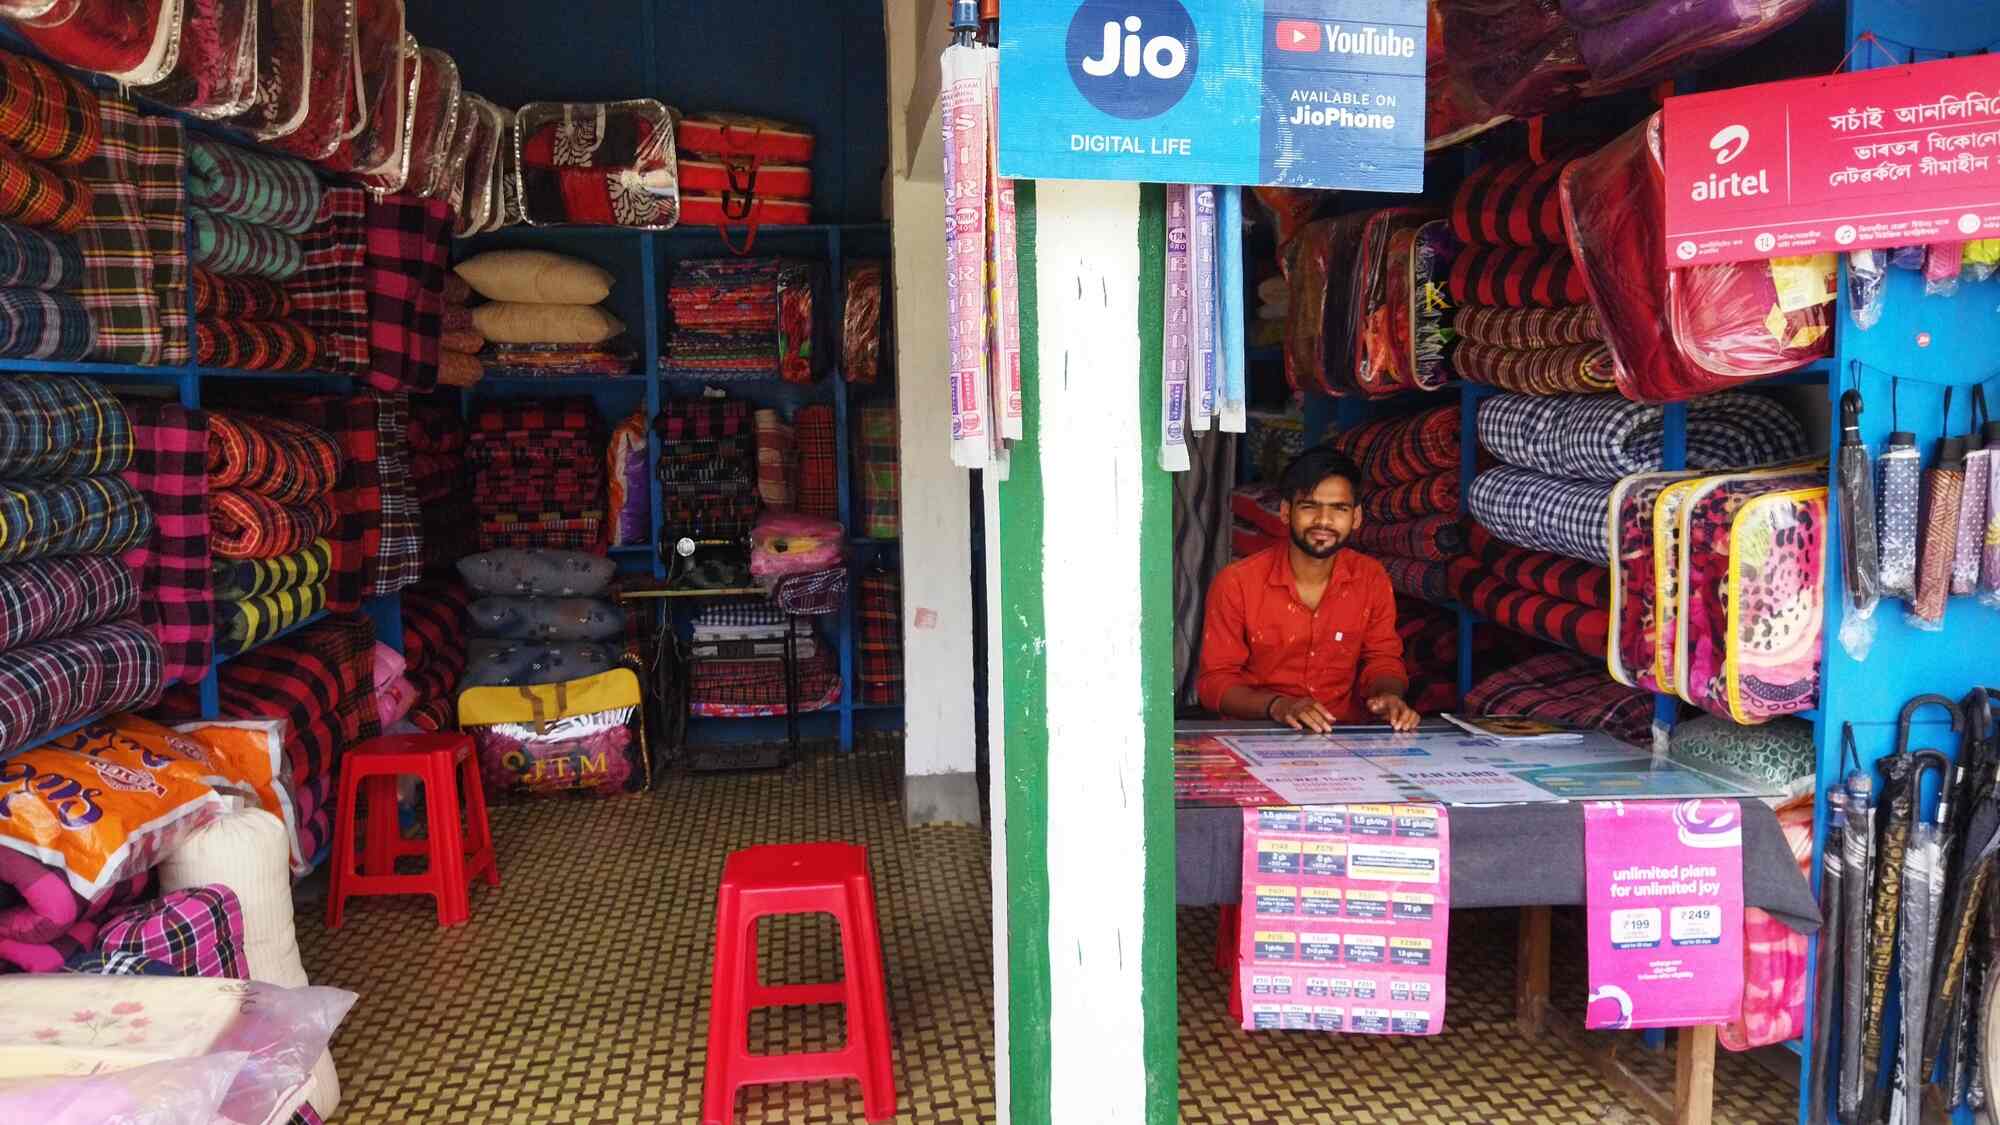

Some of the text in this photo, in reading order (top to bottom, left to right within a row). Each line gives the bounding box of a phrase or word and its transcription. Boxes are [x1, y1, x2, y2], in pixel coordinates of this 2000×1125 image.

[1082, 16, 1186, 80] Jio
[1325, 24, 1415, 58] YouTube
[1290, 89, 1397, 108] AVAILABLE ON
[1290, 107, 1396, 130] JioPhone
[1071, 134, 1192, 156] DIGITAL LIFE
[1691, 169, 1769, 202] airtel
[1612, 864, 1717, 882] unlimited plans
[1610, 880, 1720, 897] for unlimited joy
